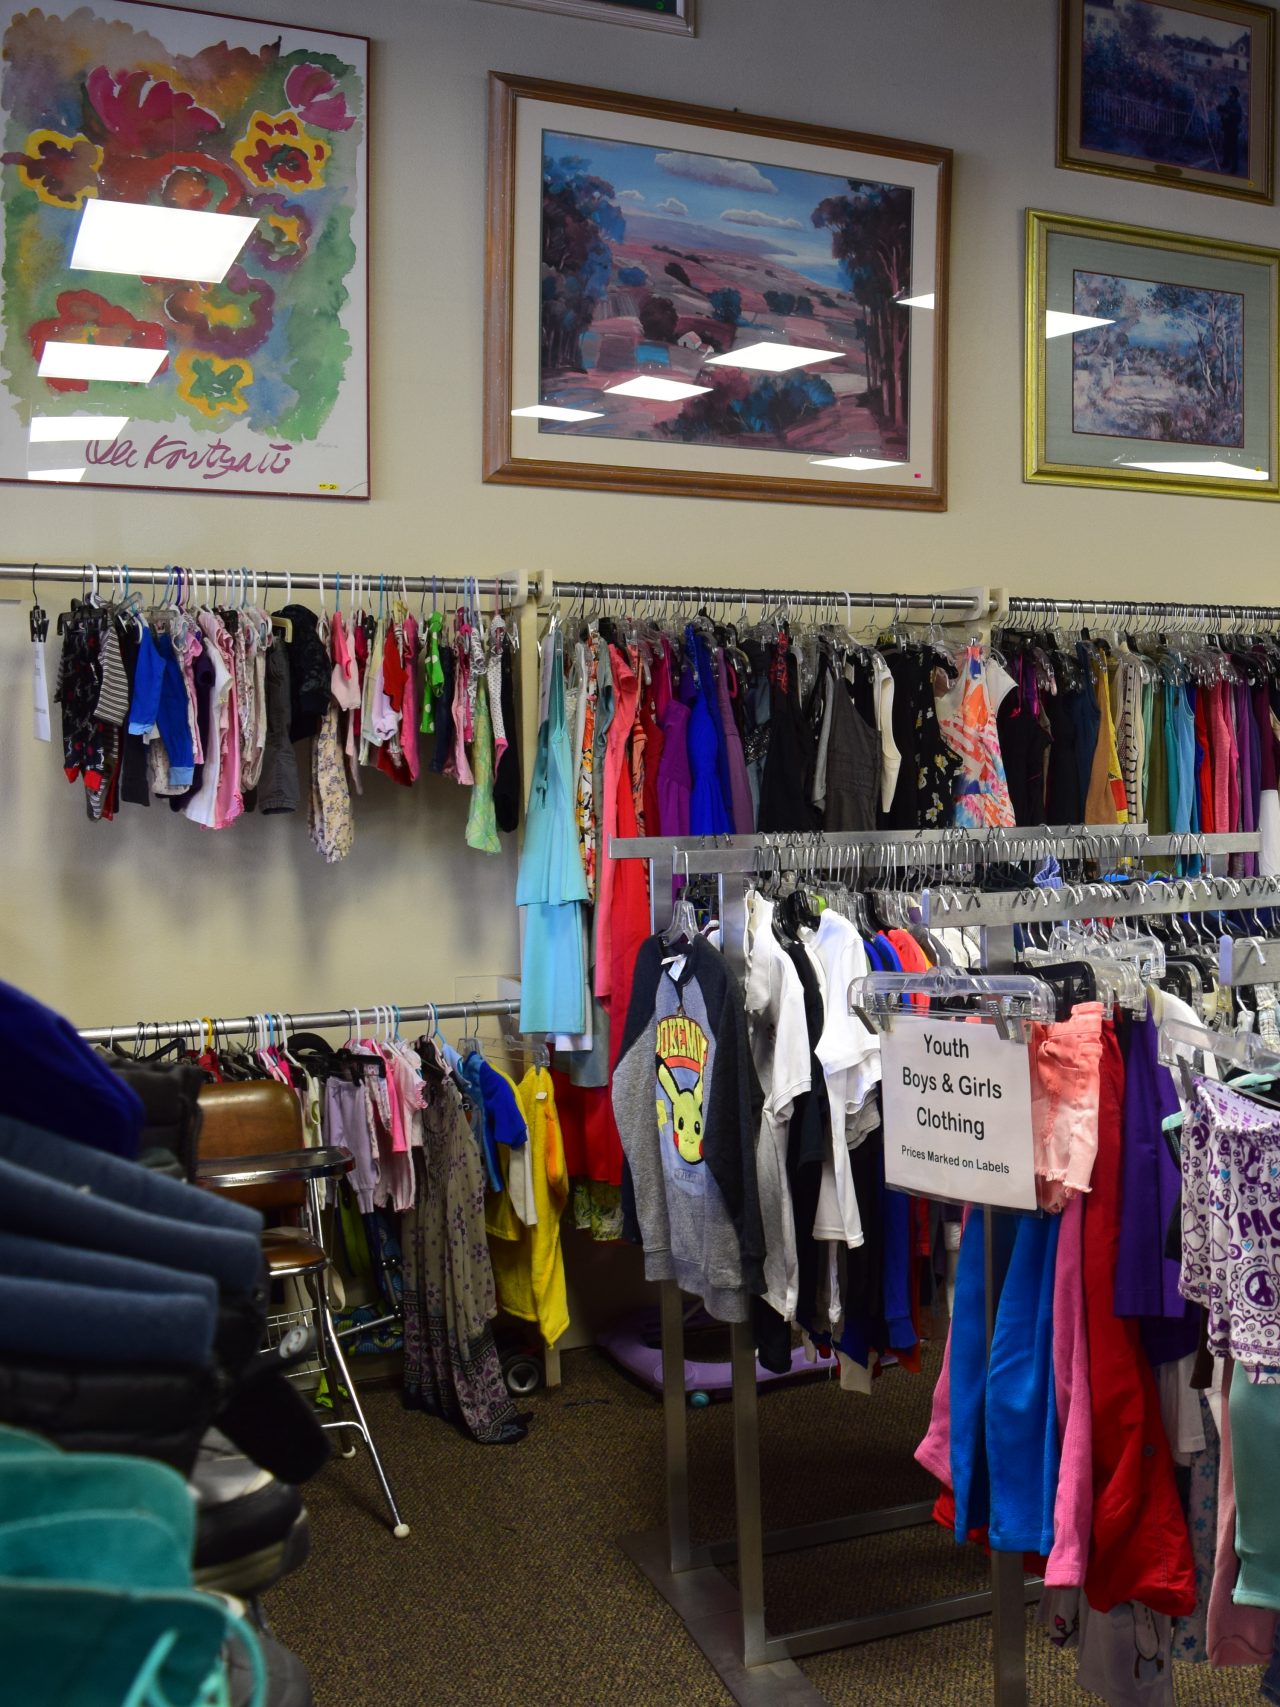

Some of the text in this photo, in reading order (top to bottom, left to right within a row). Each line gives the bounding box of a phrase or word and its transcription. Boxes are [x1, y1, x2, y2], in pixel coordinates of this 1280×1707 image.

[923, 1034, 969, 1059] Youth
[903, 1067, 1002, 1099] Boys & Girls
[916, 1106, 985, 1140] Clothing
[901, 1145, 1010, 1174] Prices Marked on Labels
